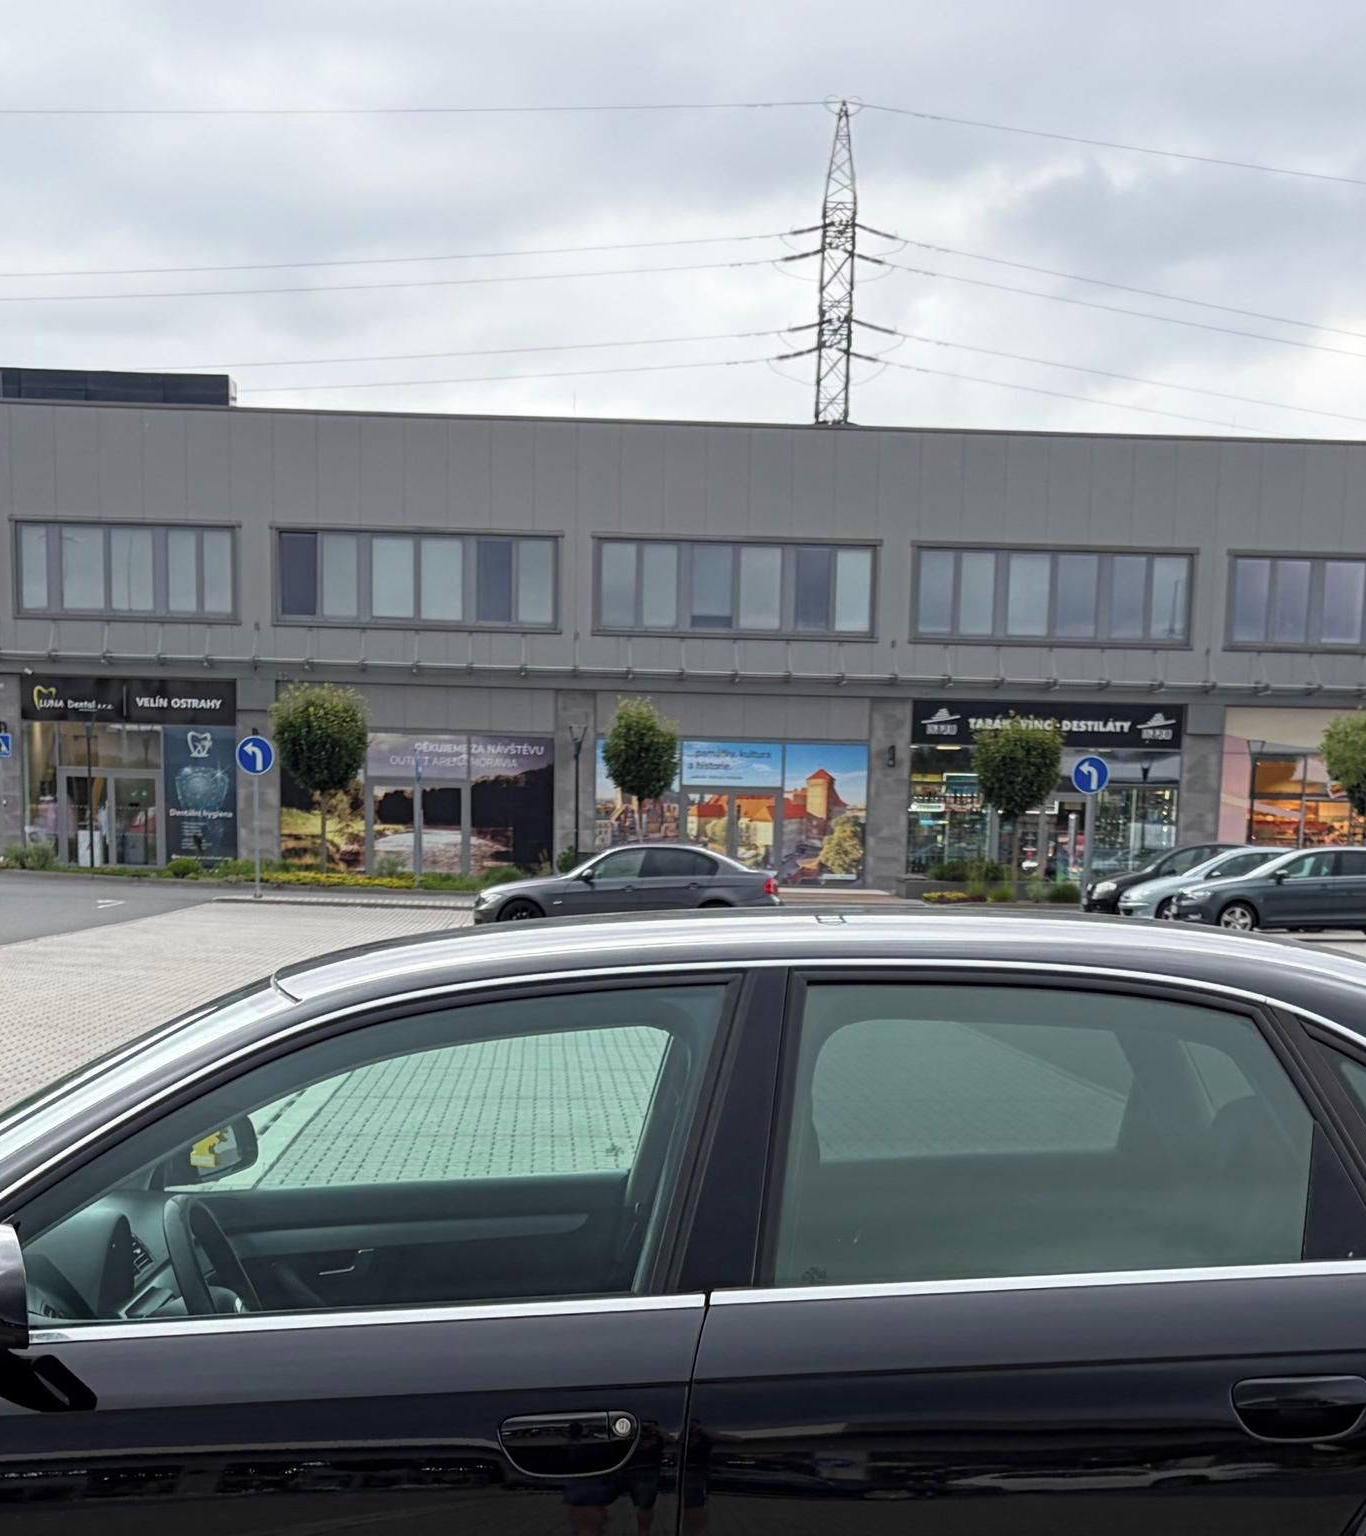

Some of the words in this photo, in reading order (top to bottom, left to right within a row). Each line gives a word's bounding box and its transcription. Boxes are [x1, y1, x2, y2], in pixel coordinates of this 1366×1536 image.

[67, 699, 96, 709] Dental
[136, 696, 168, 708] VELÍN
[170, 698, 222, 709] OSTRAHY
[1061, 718, 1132, 732] DESTILÁTY
[470, 744, 484, 754] ZA
[487, 742, 544, 756] NÁVŠTĚVU
[389, 755, 430, 766] OUTLT
